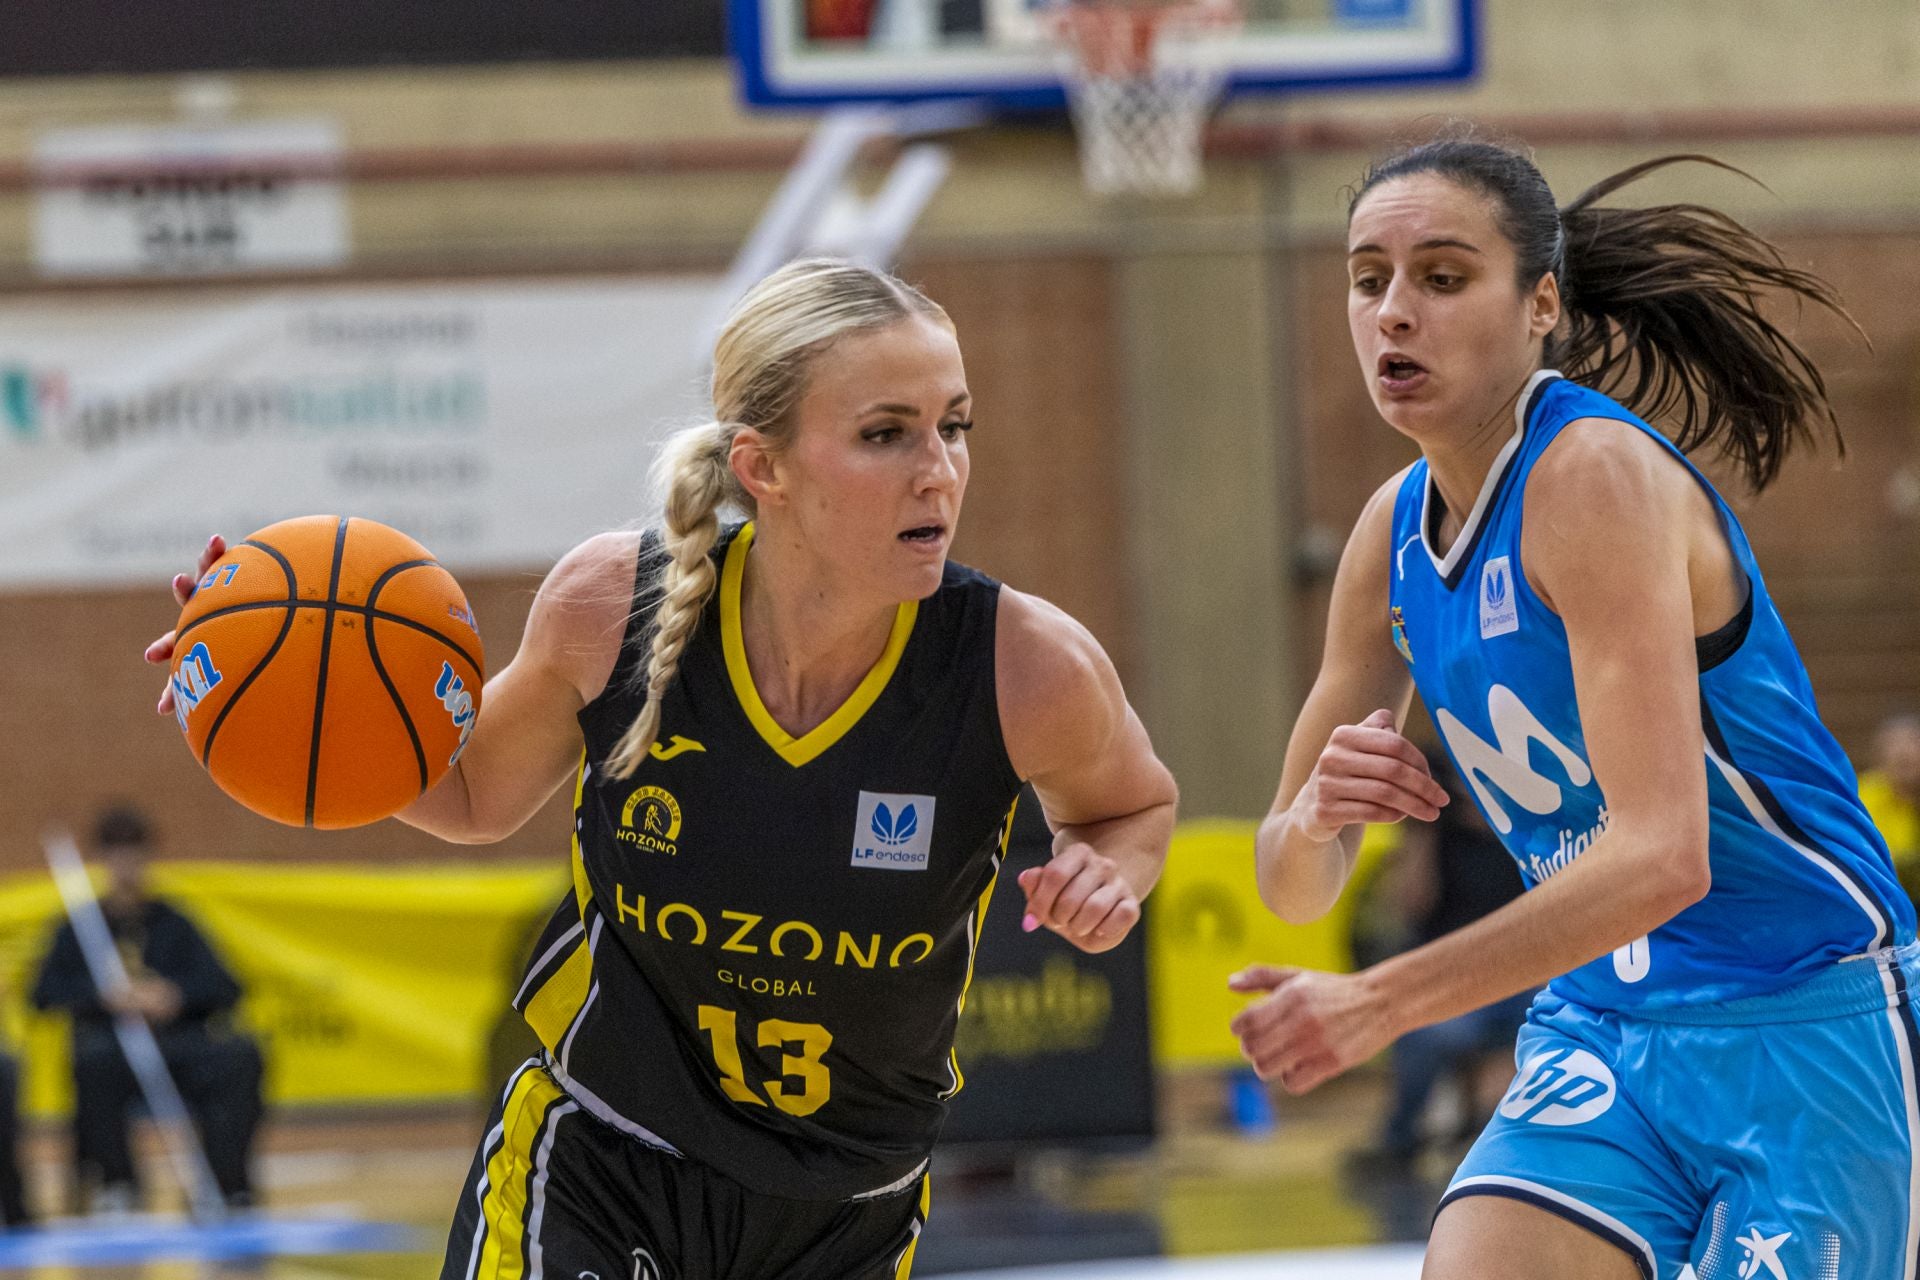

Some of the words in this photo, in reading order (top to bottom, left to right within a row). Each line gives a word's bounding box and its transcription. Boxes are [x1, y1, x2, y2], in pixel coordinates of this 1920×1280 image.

[616, 828, 677, 856] HOZONO
[855, 847, 874, 859] LF
[875, 851, 927, 863] endesa
[616, 883, 935, 969] HOZONO
[717, 969, 817, 997] GLOBAL
[698, 1004, 834, 1117] 13
[1503, 1048, 1610, 1122] hp
